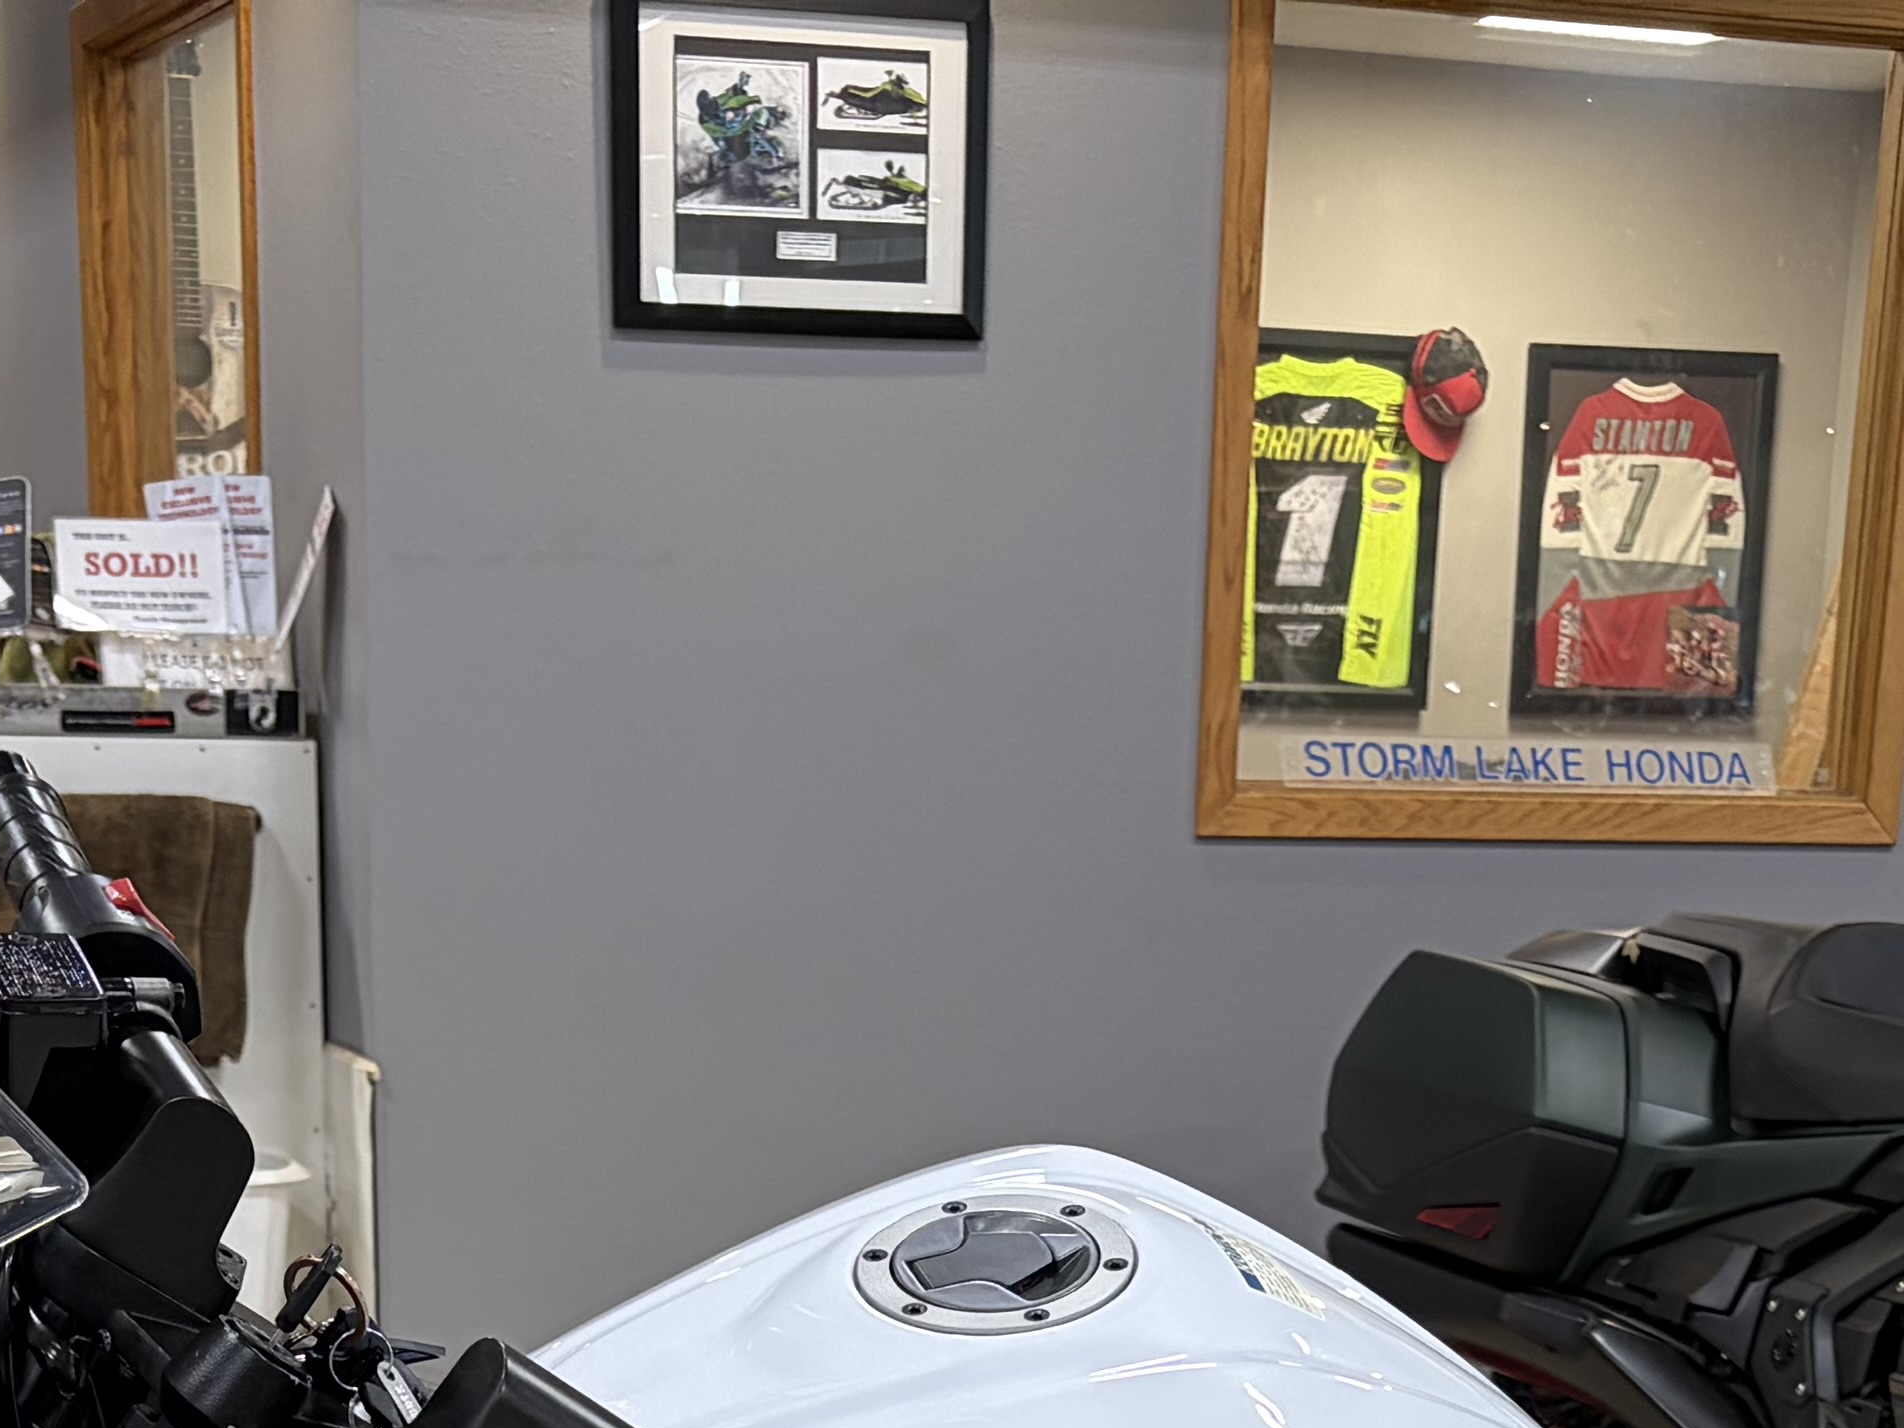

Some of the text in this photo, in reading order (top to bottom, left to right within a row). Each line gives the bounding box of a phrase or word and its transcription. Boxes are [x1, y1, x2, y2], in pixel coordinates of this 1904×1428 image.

[1251, 424, 1375, 463] BRAYTON
[1592, 418, 1694, 452] STANTON
[1614, 464, 1660, 553] 7
[1276, 474, 1348, 587] 1
[84, 552, 199, 578] SOLD!!
[1303, 740, 1752, 786] STORM LAKE HONDA
